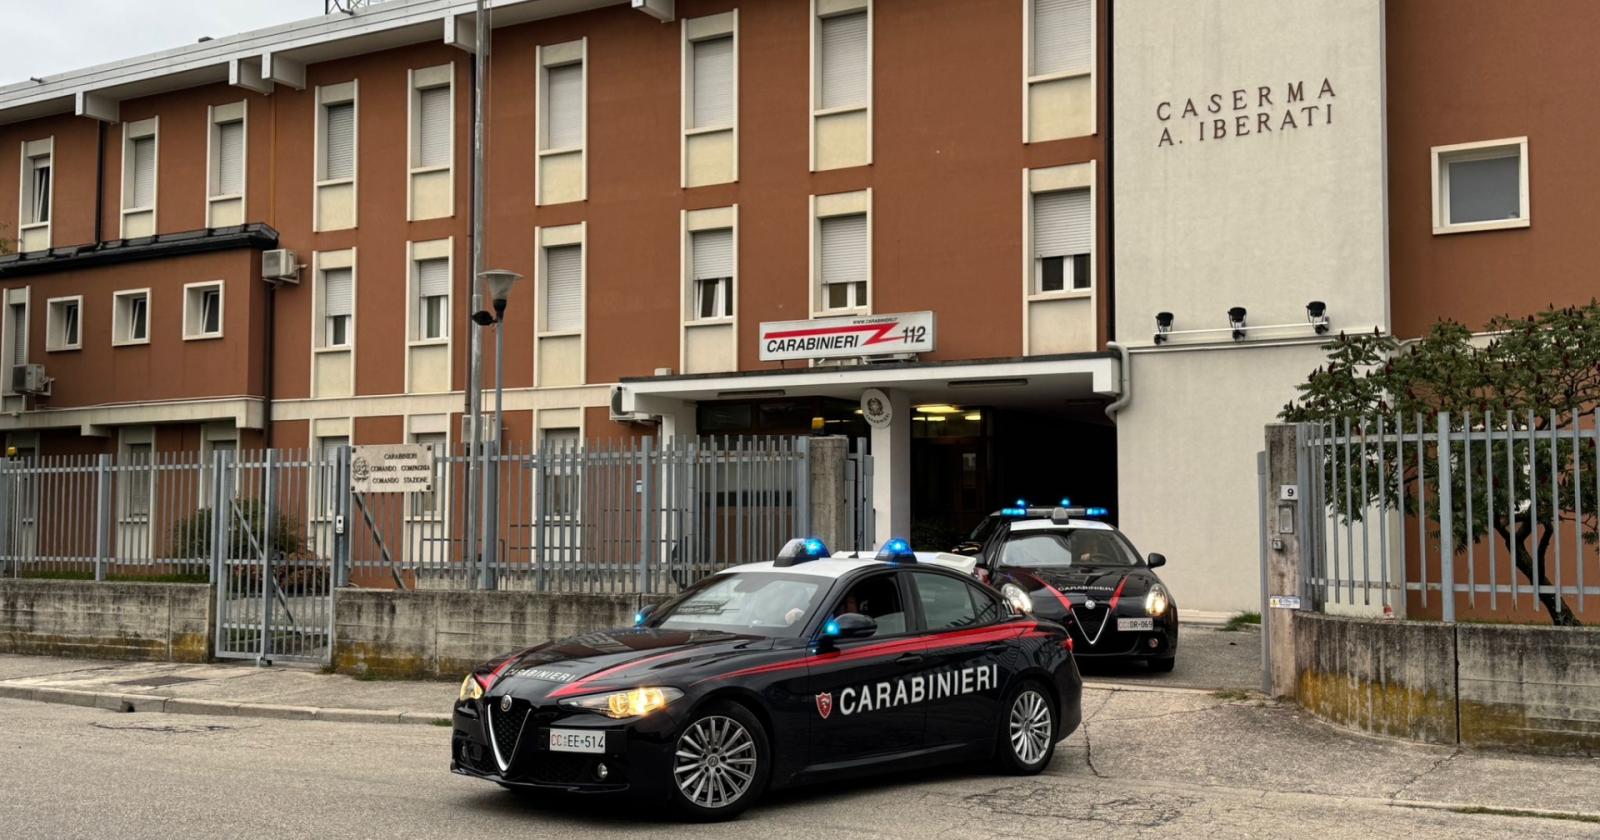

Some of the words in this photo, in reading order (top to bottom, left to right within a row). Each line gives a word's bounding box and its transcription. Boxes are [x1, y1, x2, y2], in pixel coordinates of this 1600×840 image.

[1156, 77, 1336, 121] CASERMA
[1158, 127, 1184, 147] A.
[1199, 103, 1332, 141] IBERATI
[767, 334, 860, 353] CARABINIERI
[902, 326, 926, 344] 112
[1287, 488, 1294, 497] 9
[840, 664, 998, 716] CARABINIERI
